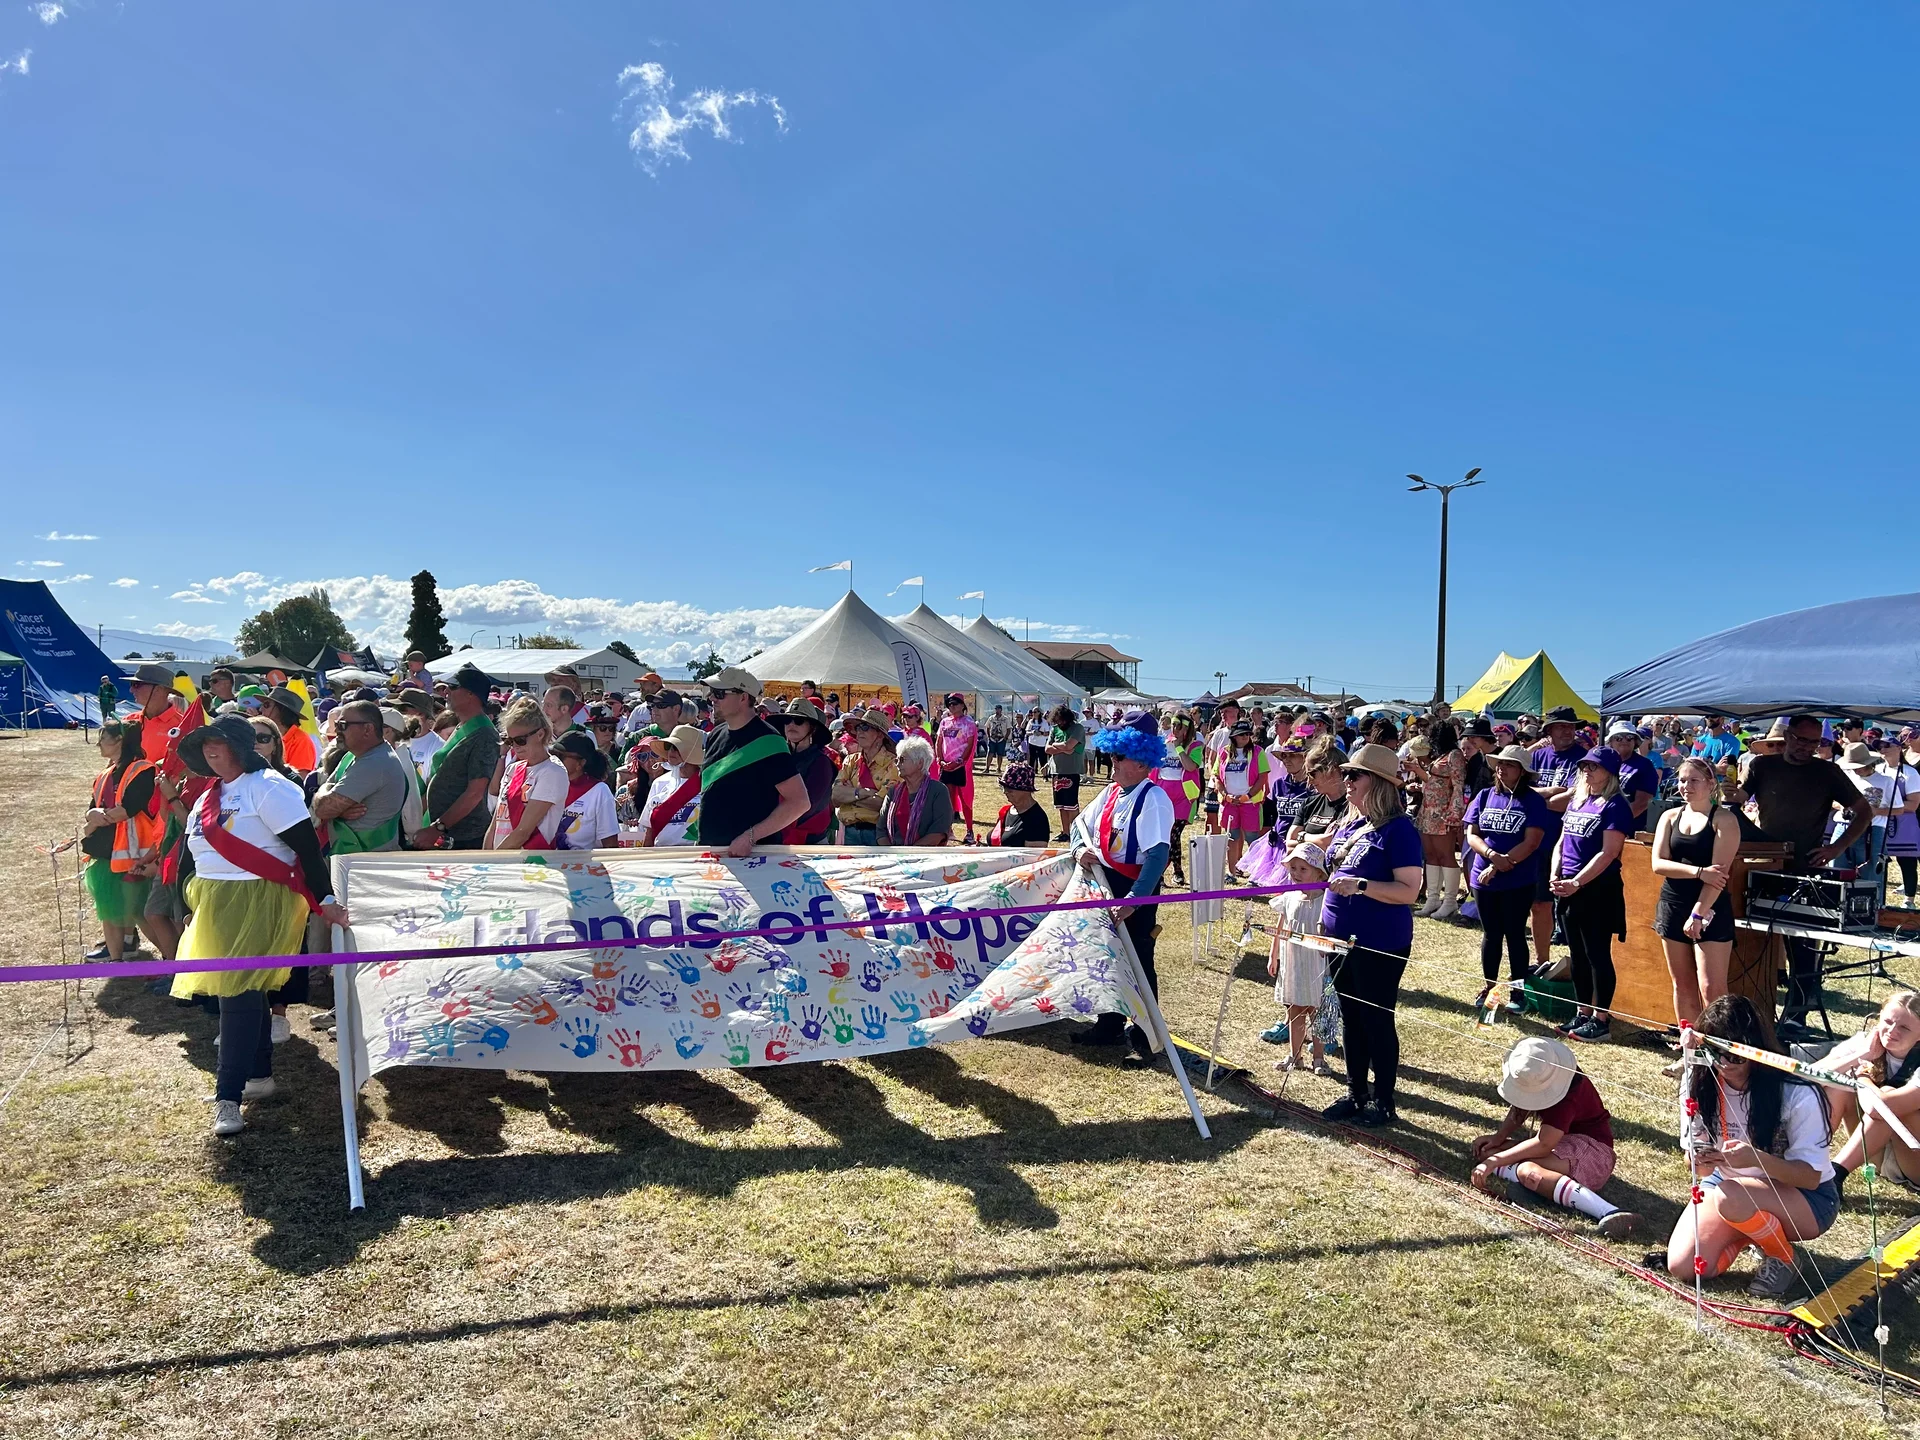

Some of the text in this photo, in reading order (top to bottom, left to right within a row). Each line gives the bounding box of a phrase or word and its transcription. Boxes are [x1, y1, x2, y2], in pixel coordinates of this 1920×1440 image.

[14, 611, 44, 623] Cancer
[20, 623, 52, 636] Society
[902, 651, 917, 700] TINENTAL
[1487, 813, 1517, 822] RELAY
[1491, 820, 1514, 830] LIFE
[474, 893, 1043, 963] Hands of Hope
